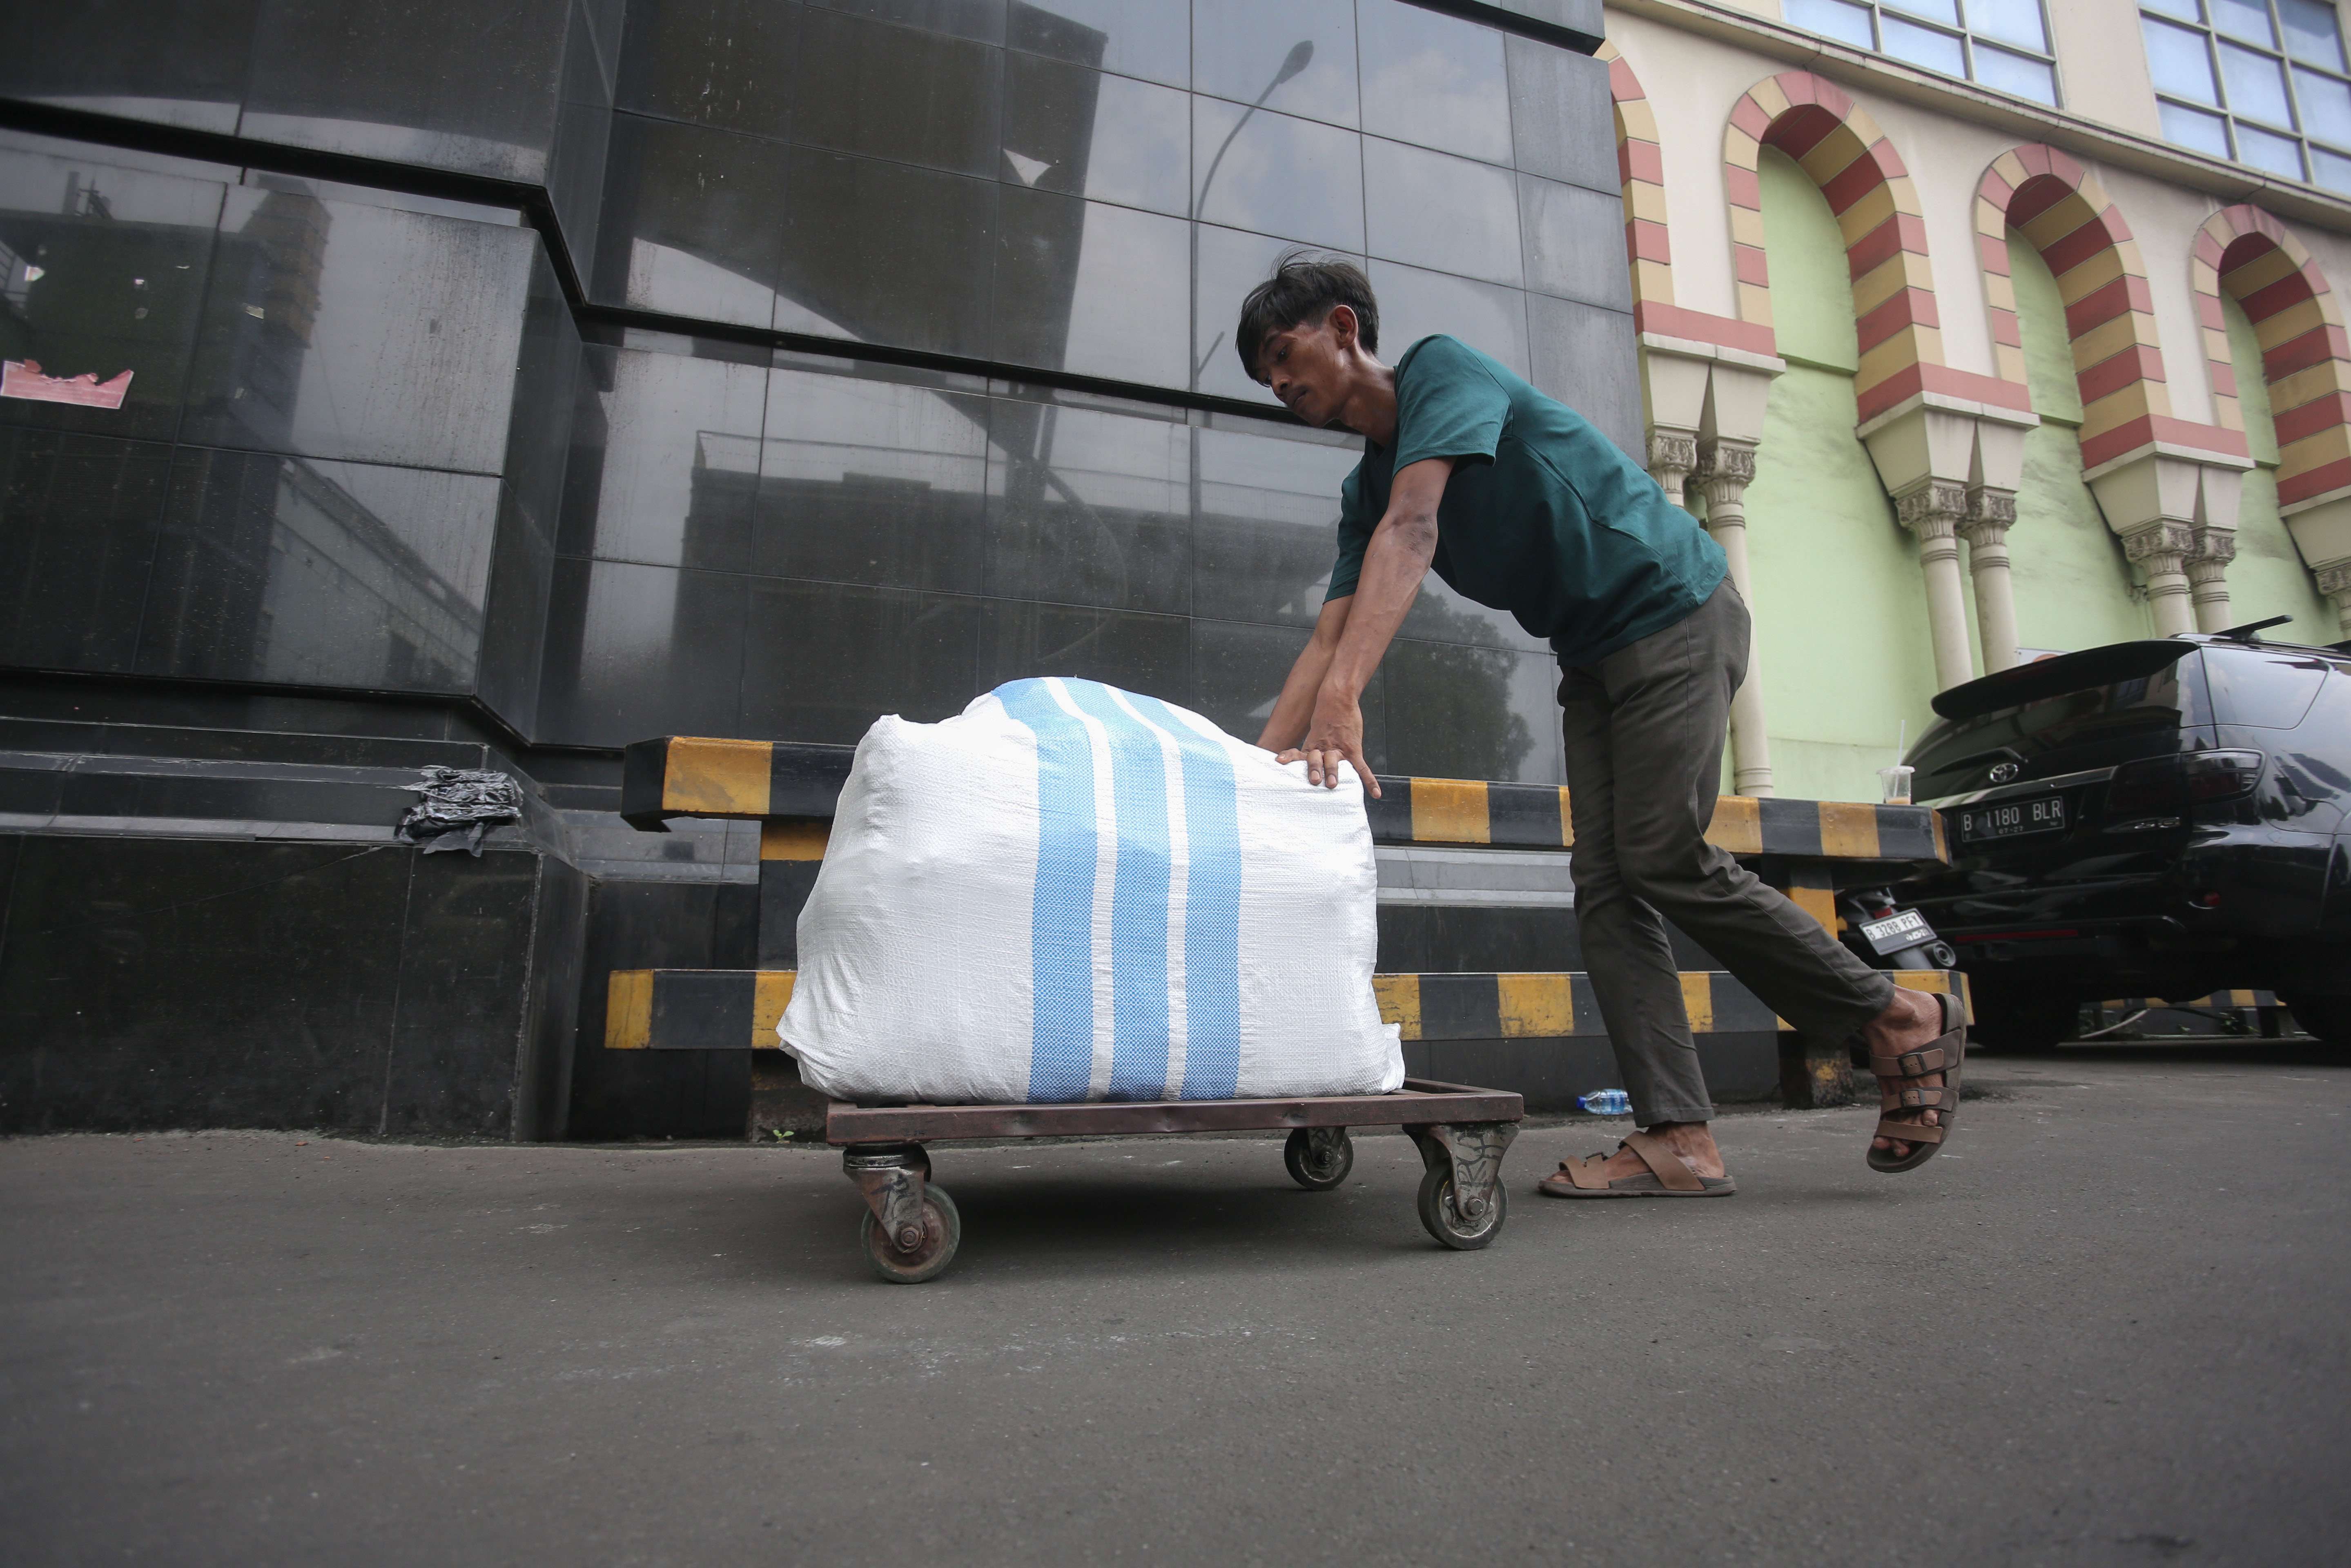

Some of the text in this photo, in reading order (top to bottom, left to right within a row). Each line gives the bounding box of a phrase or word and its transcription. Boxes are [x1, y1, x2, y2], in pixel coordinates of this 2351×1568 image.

[1964, 800, 2061, 831] B 1180 BLR
[1865, 915, 1921, 940] B 3288 PFY
